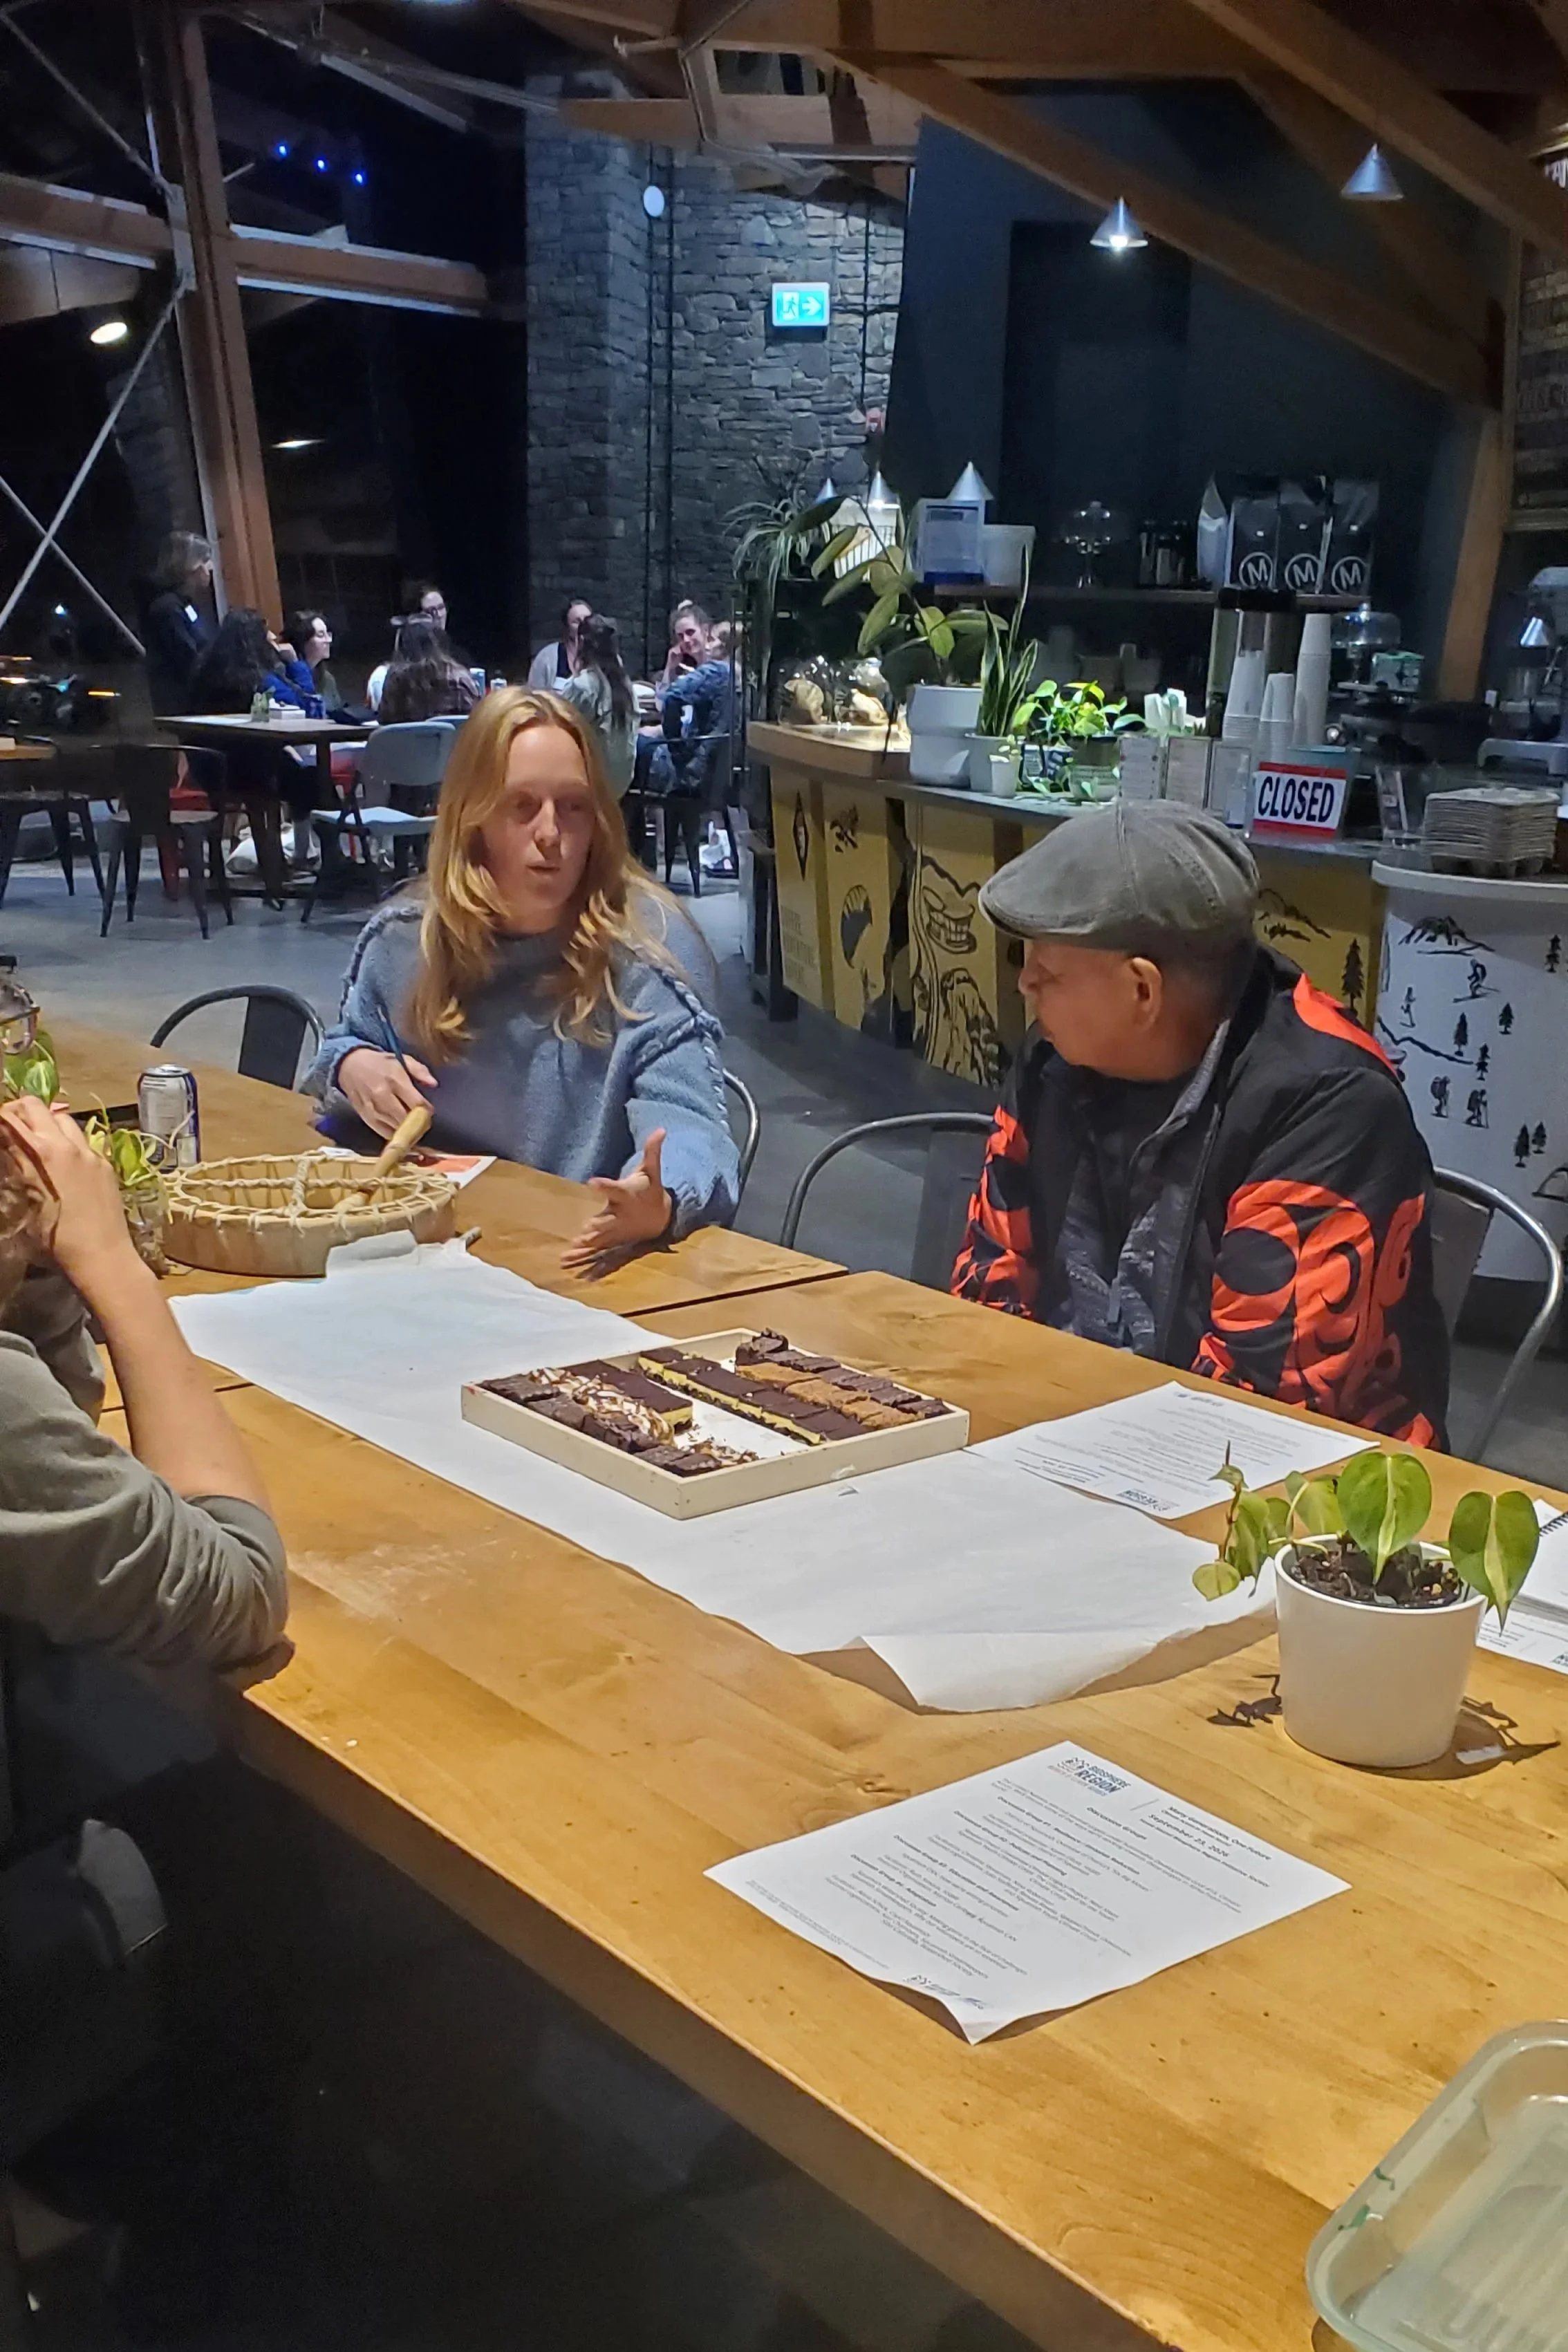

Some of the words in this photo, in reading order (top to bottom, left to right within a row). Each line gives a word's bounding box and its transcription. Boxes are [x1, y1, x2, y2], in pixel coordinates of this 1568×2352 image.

[1258, 776, 1334, 823] CLOSED
[1074, 1770, 1121, 1793] REGION
[1087, 1807, 1122, 1827] Discussion
[1148, 1814, 1193, 1838] September
[1247, 1847, 1271, 1860] Future
